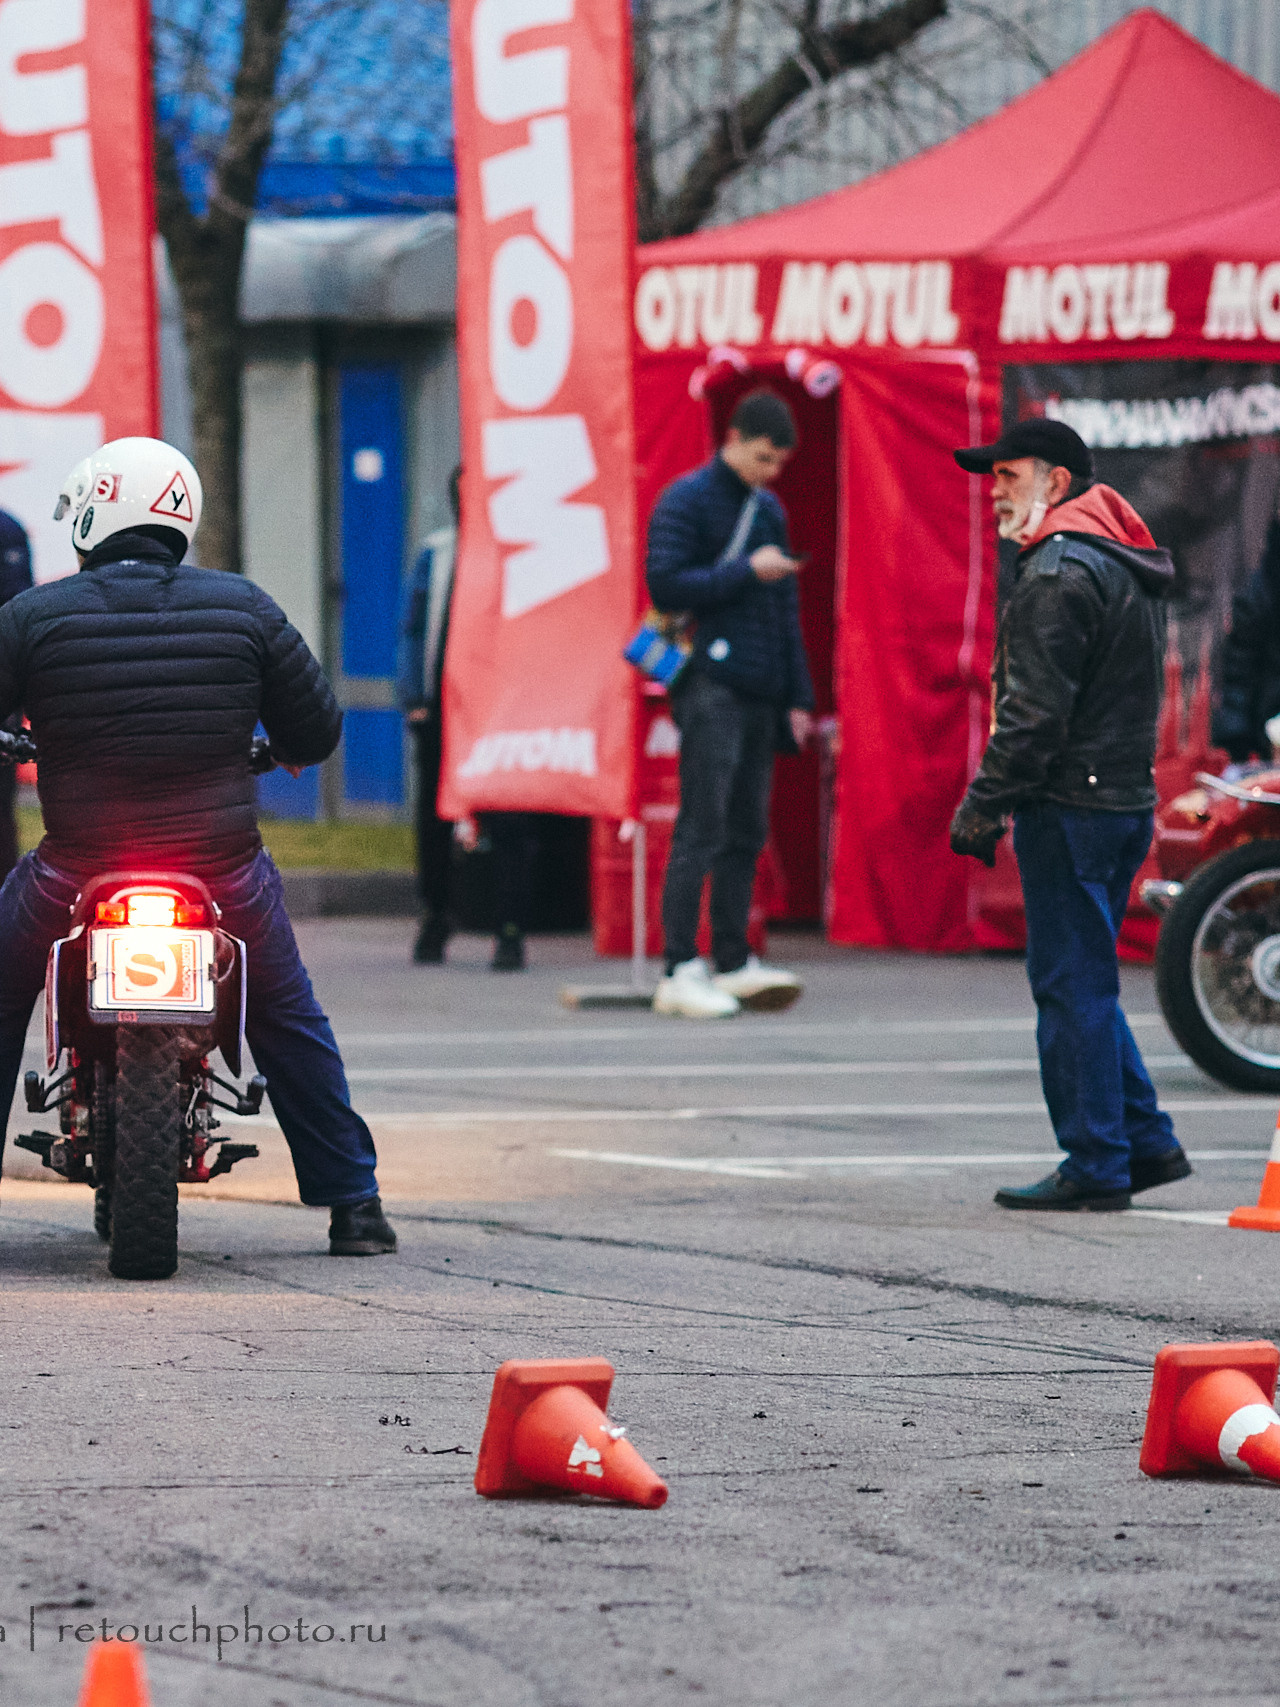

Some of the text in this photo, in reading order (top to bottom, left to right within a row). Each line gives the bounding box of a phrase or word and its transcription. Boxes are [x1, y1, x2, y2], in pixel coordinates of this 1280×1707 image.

[634, 260, 959, 351] OTUL MOTUL
[998, 261, 1280, 344] MOTUL MO
